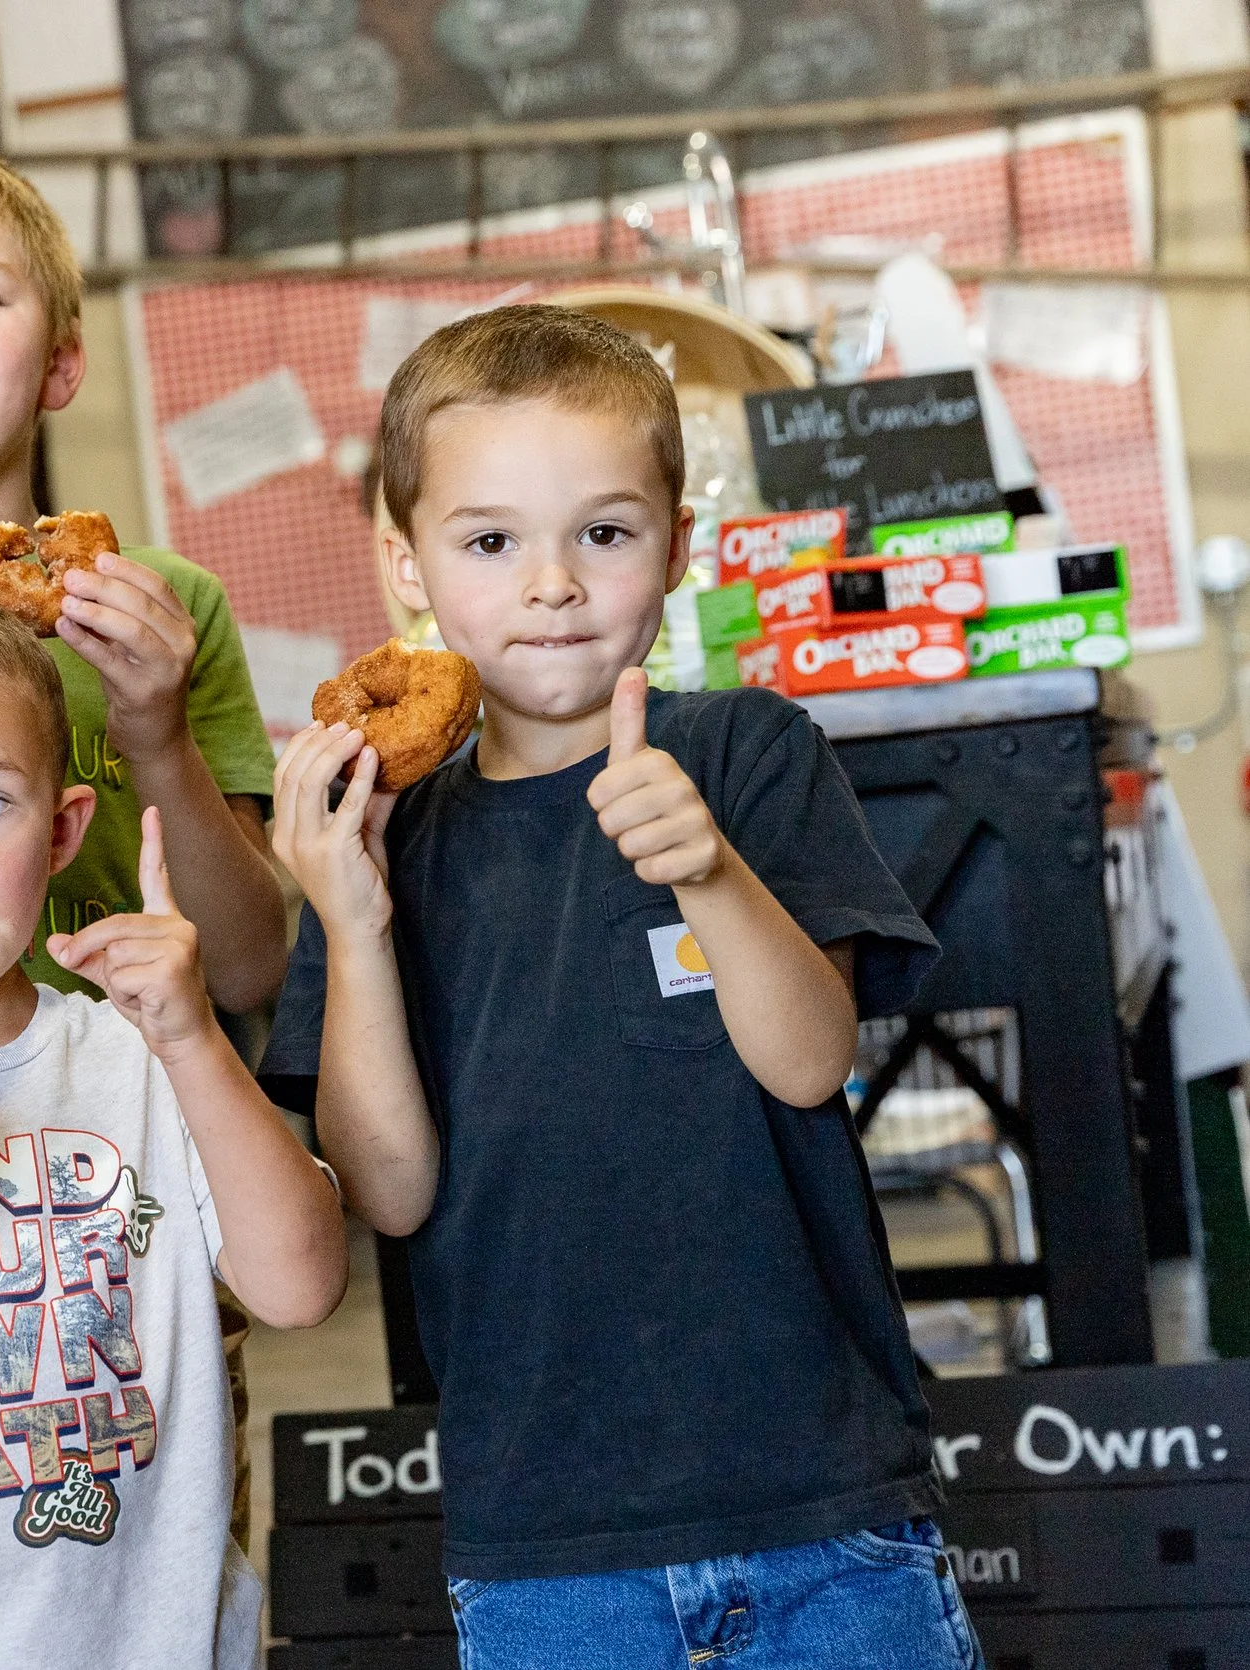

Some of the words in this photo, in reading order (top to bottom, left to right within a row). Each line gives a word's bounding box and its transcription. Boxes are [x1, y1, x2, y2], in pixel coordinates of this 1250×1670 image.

[761, 396, 845, 446] Little
[823, 442, 867, 480] for
[792, 623, 921, 676] ORCHARD
[966, 612, 1087, 668] ORCHARD
[669, 973, 712, 987] carhart
[1013, 1404, 1228, 1476] Own:
[62, 1460, 94, 1484] It's
[302, 1426, 442, 1505] Tod
[28, 1490, 109, 1534] Good
[60, 1481, 104, 1513] All
